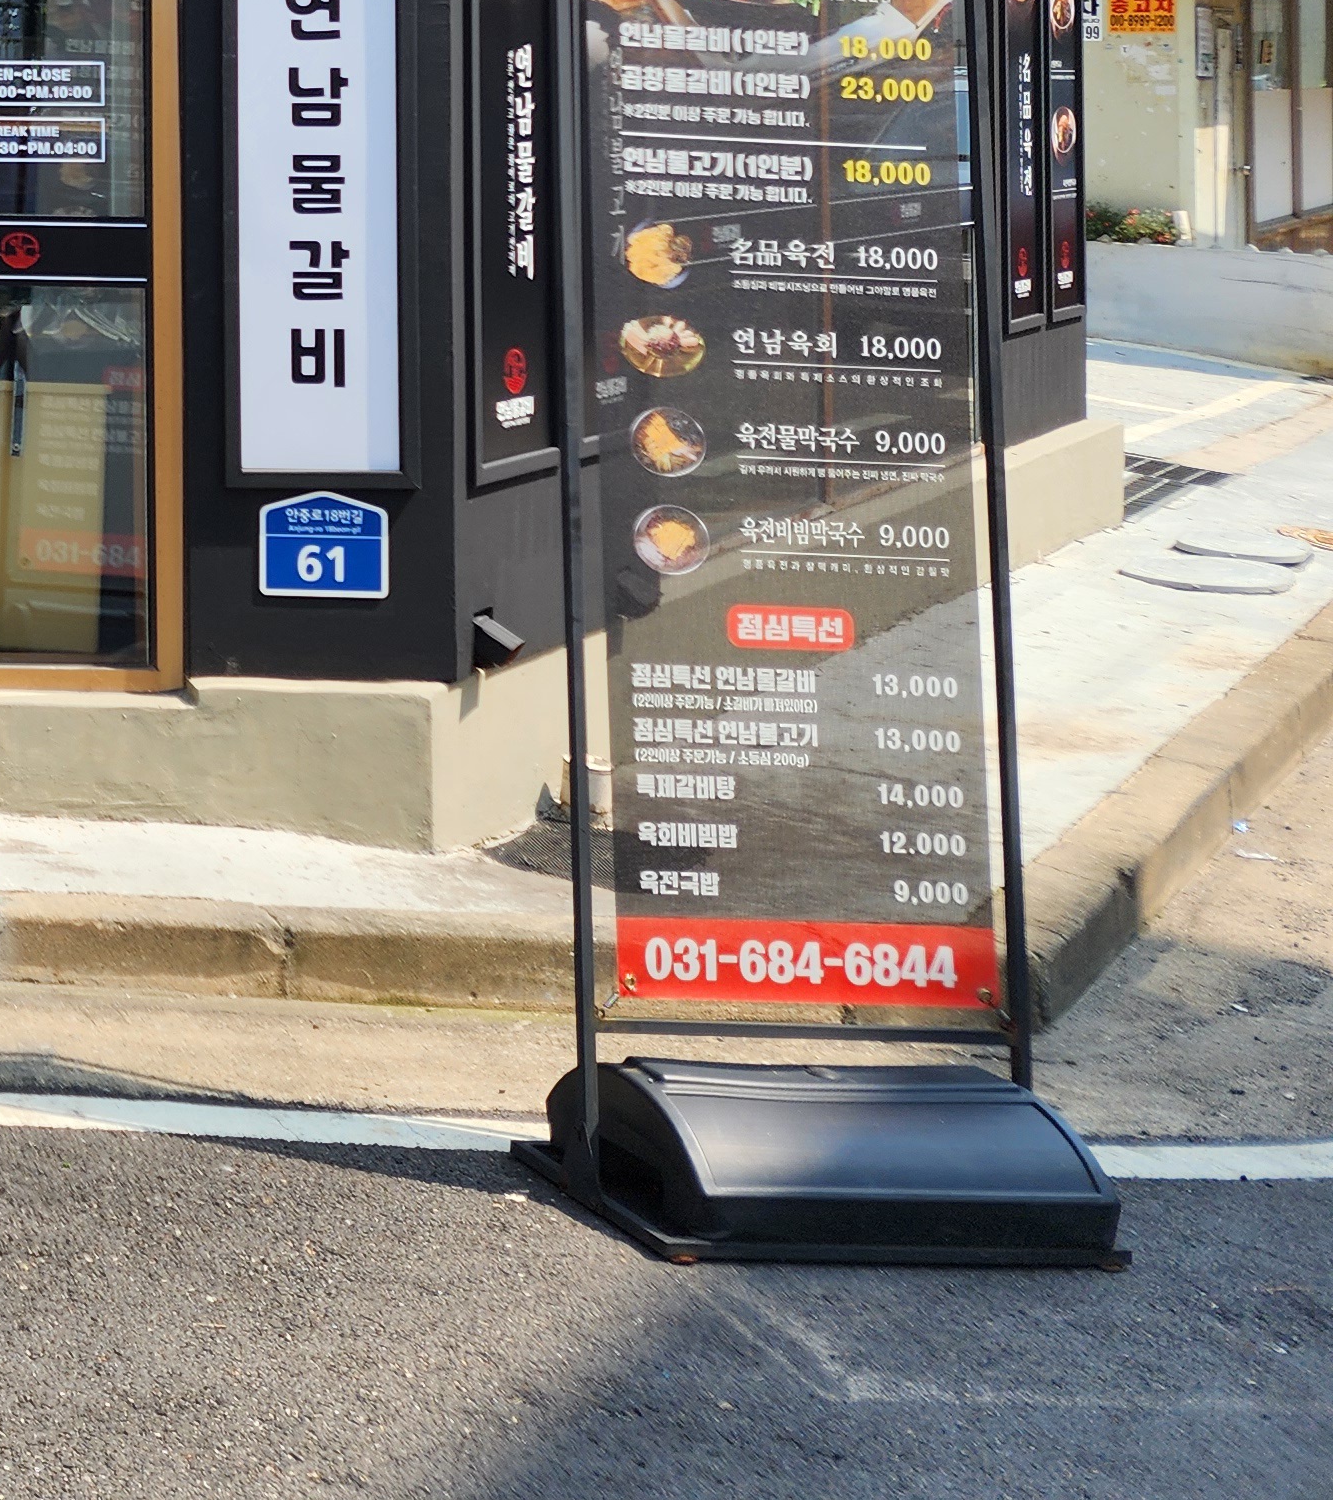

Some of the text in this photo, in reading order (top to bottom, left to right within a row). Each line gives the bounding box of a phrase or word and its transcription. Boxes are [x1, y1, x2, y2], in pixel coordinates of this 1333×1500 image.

[840, 75, 935, 104] 23,000
[672, 105, 701, 122] 이상
[702, 107, 731, 124] 주문
[732, 108, 761, 125] 가능
[29, 127, 61, 139] TIME
[515, 43, 538, 281] 연남물갈비
[842, 159, 932, 187] 18,000
[674, 182, 703, 199] 이상
[704, 183, 733, 201] 주문
[734, 184, 763, 202] 가능
[856, 245, 939, 271] 18,000
[732, 327, 942, 361] 연남육회 18,000
[735, 421, 947, 456] 육전물막국수 9,000
[738, 515, 951, 549] 육전비빔막국수 9,000
[297, 544, 345, 583] 61
[736, 612, 845, 644] 점심특선
[631, 662, 959, 699] 점심특선 연남물갈비 13,000
[633, 717, 962, 754] 점심특선 연남불고기 13,000
[737, 750, 772, 768] 소등심
[772, 753, 811, 769] 200g)
[636, 773, 965, 809] 특제갈비탕 14,000
[637, 821, 739, 849] 육회비빔밥
[639, 870, 970, 907] 육전국밥 9,000
[644, 936, 959, 989] 031-684-6844
